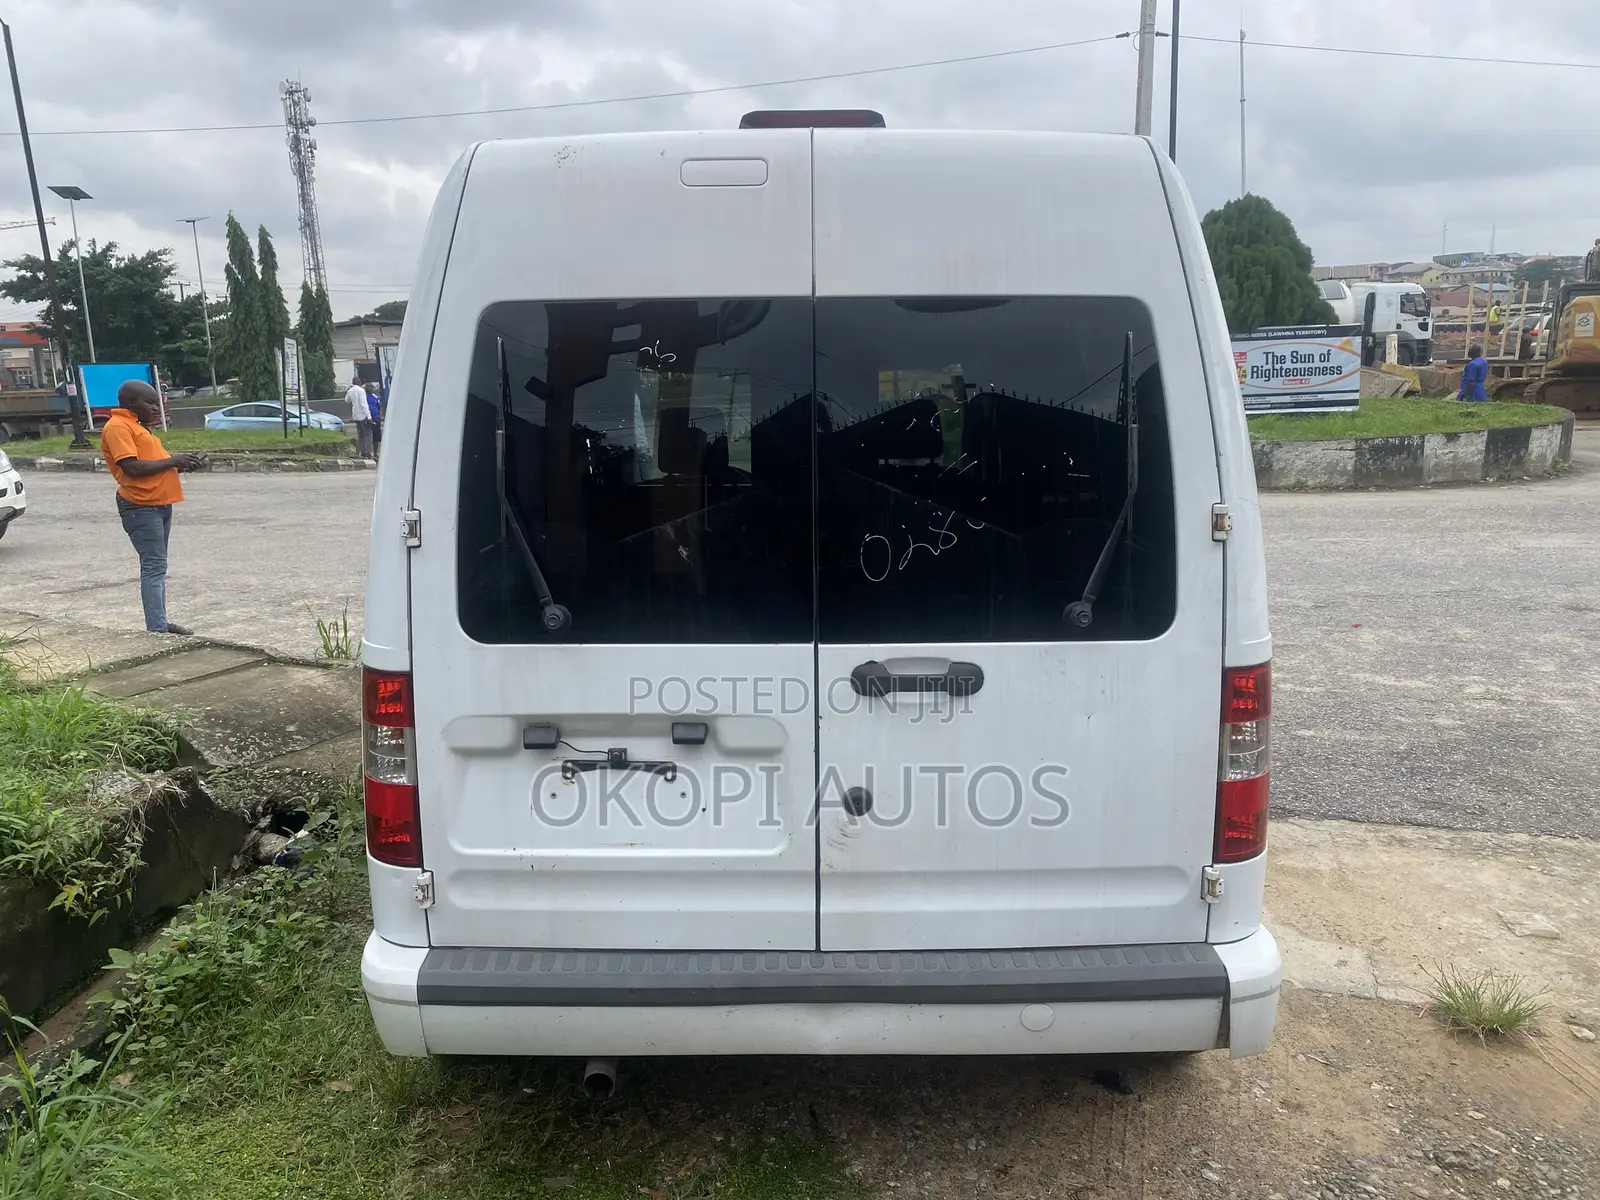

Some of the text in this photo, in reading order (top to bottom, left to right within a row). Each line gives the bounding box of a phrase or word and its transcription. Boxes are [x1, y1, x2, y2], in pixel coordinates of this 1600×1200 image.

[1263, 349, 1332, 365] The Sun of
[1250, 365, 1343, 382] Righteousness
